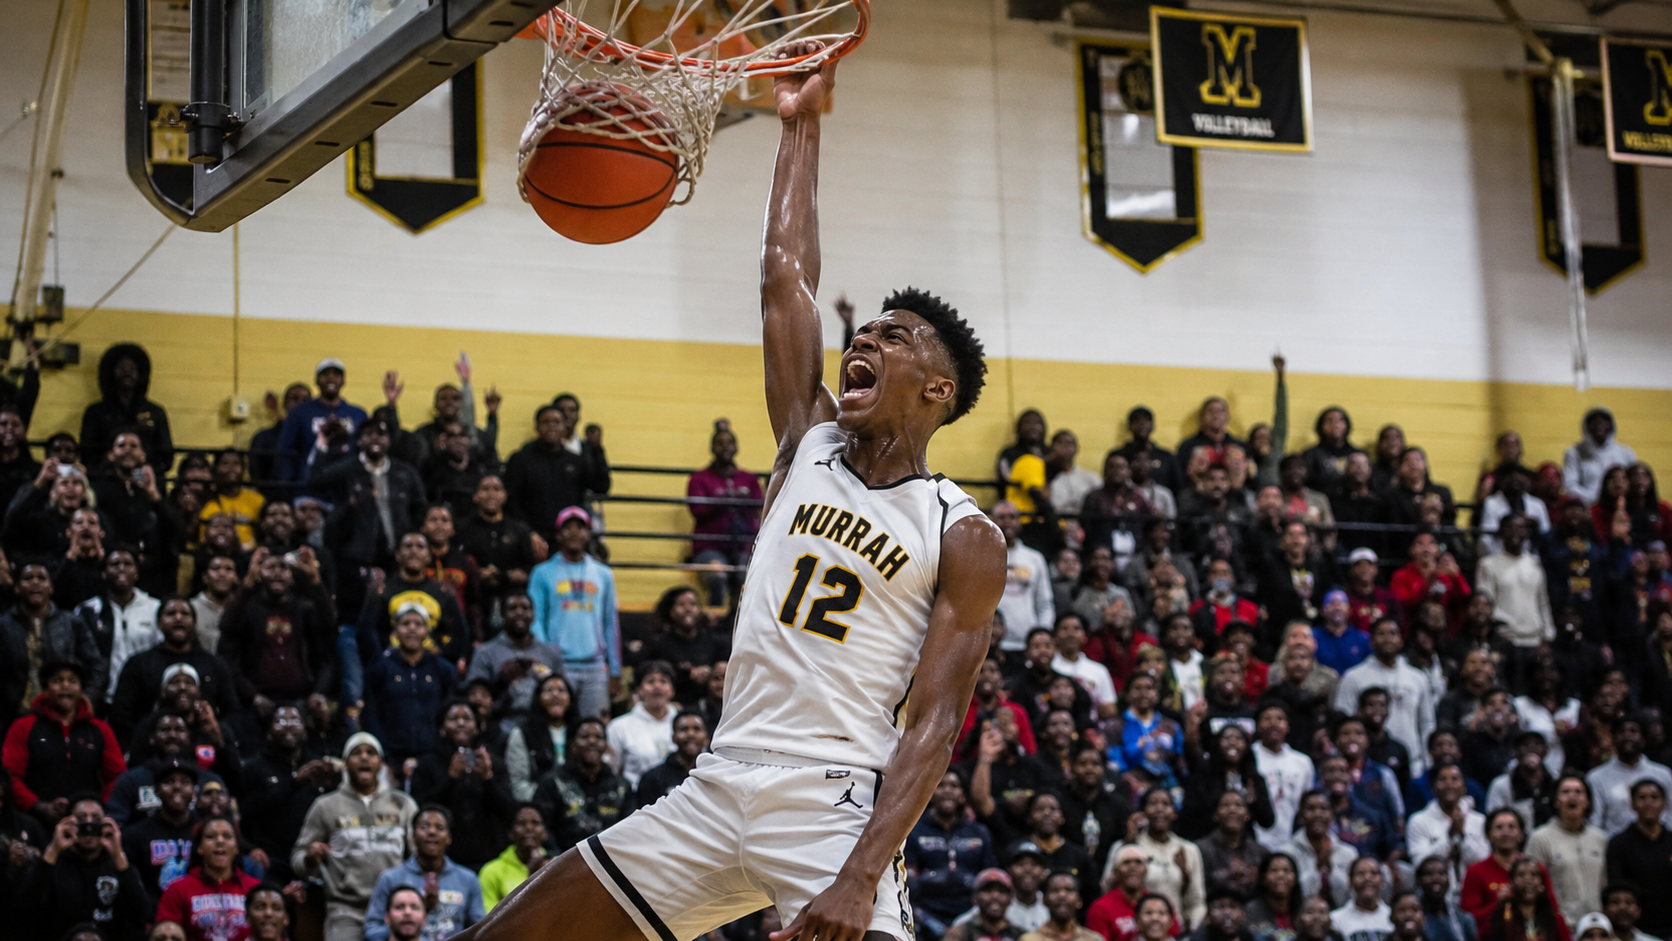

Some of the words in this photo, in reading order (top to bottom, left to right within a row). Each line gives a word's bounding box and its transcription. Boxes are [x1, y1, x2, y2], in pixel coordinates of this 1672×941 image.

[1200, 24, 1261, 107] M
[1191, 113, 1275, 138] VOLLEYBALL
[788, 503, 910, 582] MURRAH
[777, 552, 865, 644] 12
